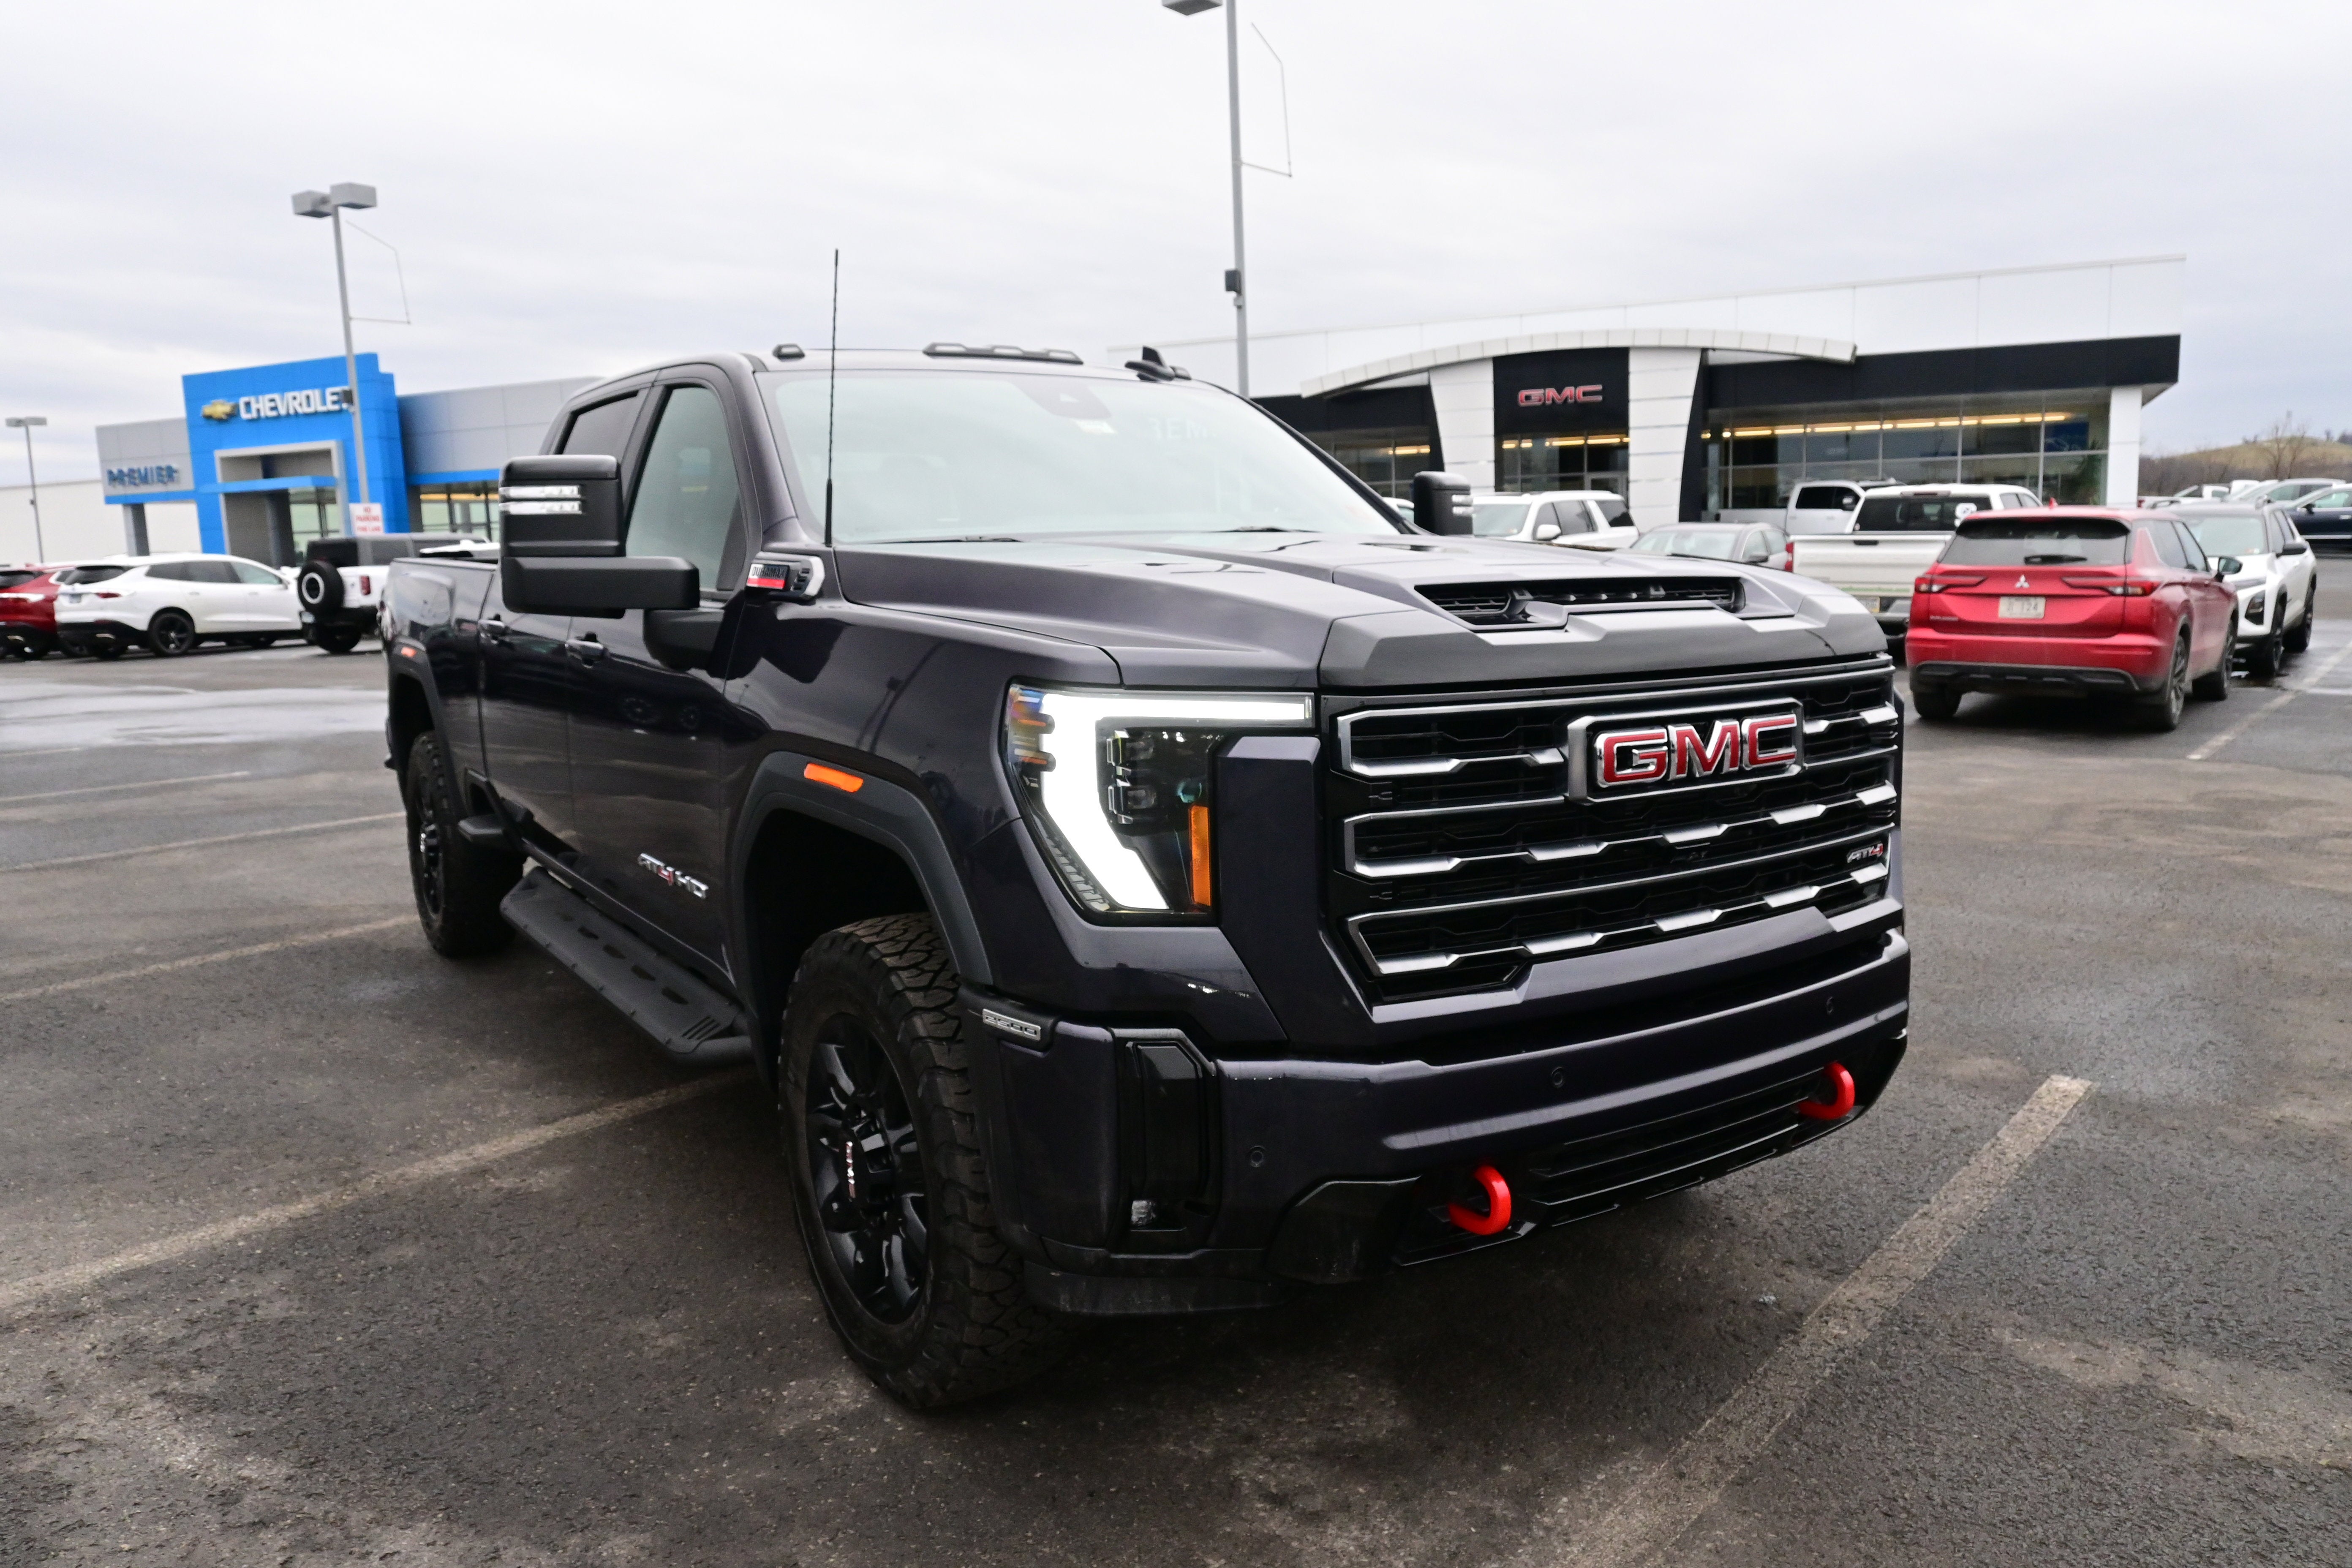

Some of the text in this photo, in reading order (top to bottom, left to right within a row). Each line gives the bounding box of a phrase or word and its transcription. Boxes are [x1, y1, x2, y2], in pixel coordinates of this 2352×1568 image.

[1519, 384, 1603, 407] GMC
[1594, 713, 1798, 788] GMC
[985, 1015, 1037, 1037] 2500
